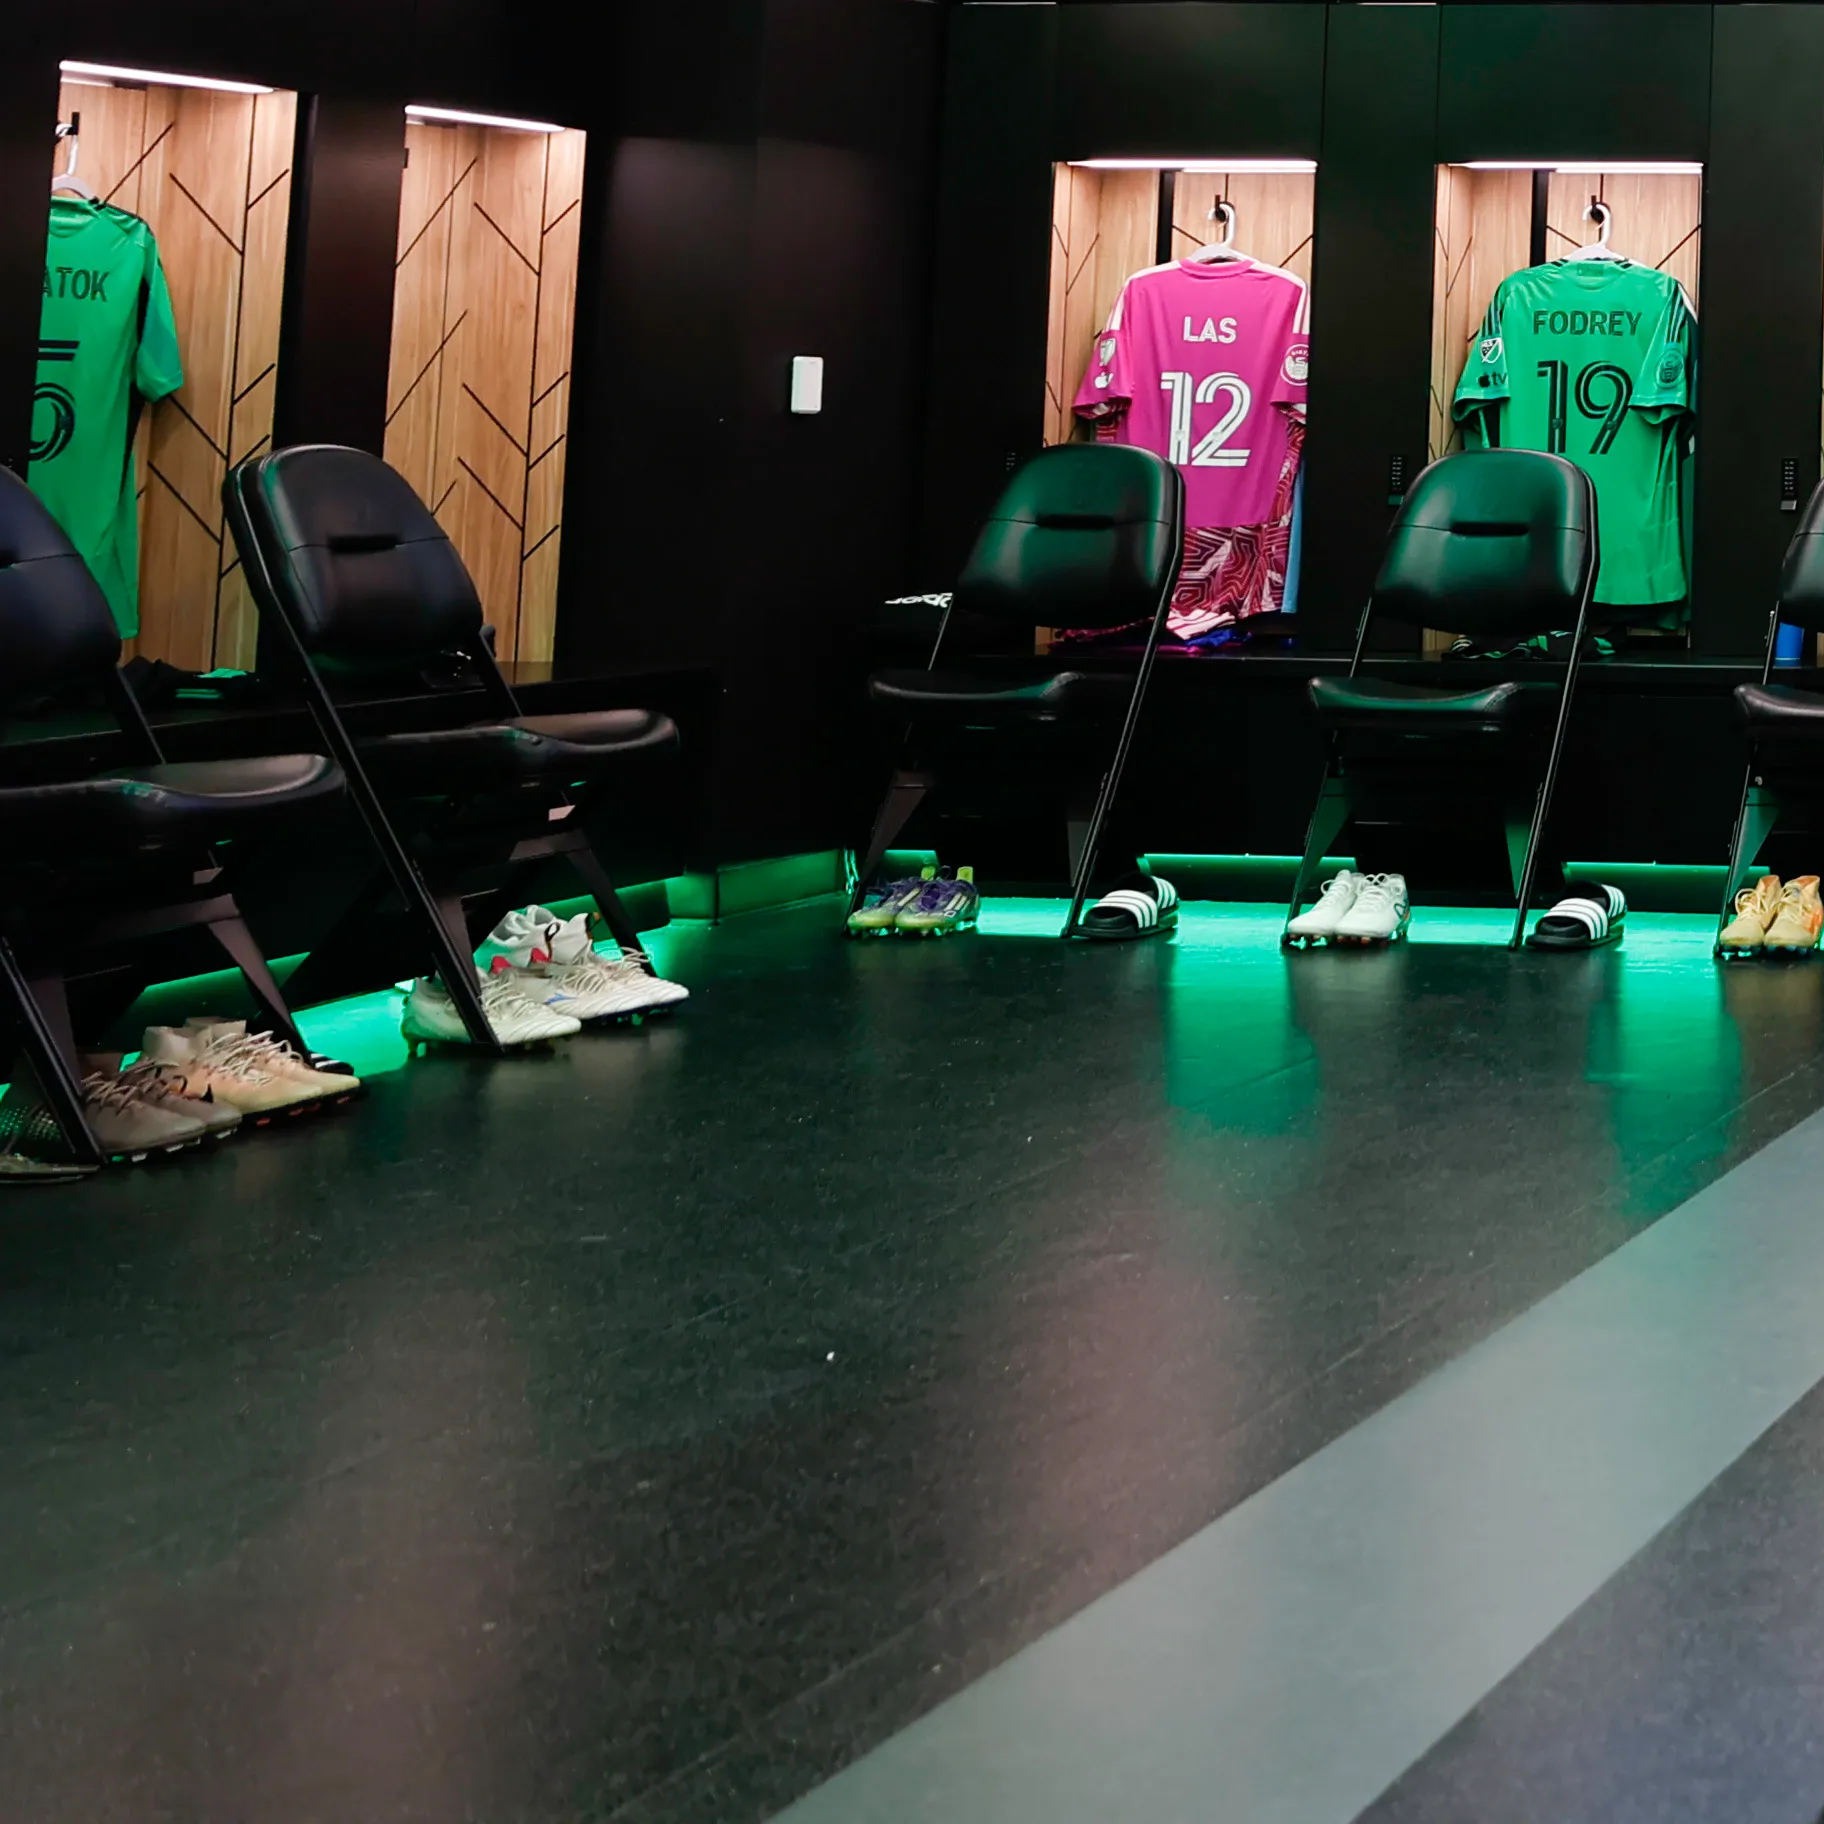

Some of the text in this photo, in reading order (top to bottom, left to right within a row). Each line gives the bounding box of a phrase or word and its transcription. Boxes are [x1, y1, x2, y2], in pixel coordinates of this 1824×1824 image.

[1183, 316, 1238, 345] LAS
[1532, 309, 1643, 337] FODREY
[1160, 371, 1252, 467] 12
[1536, 359, 1633, 455] 19
